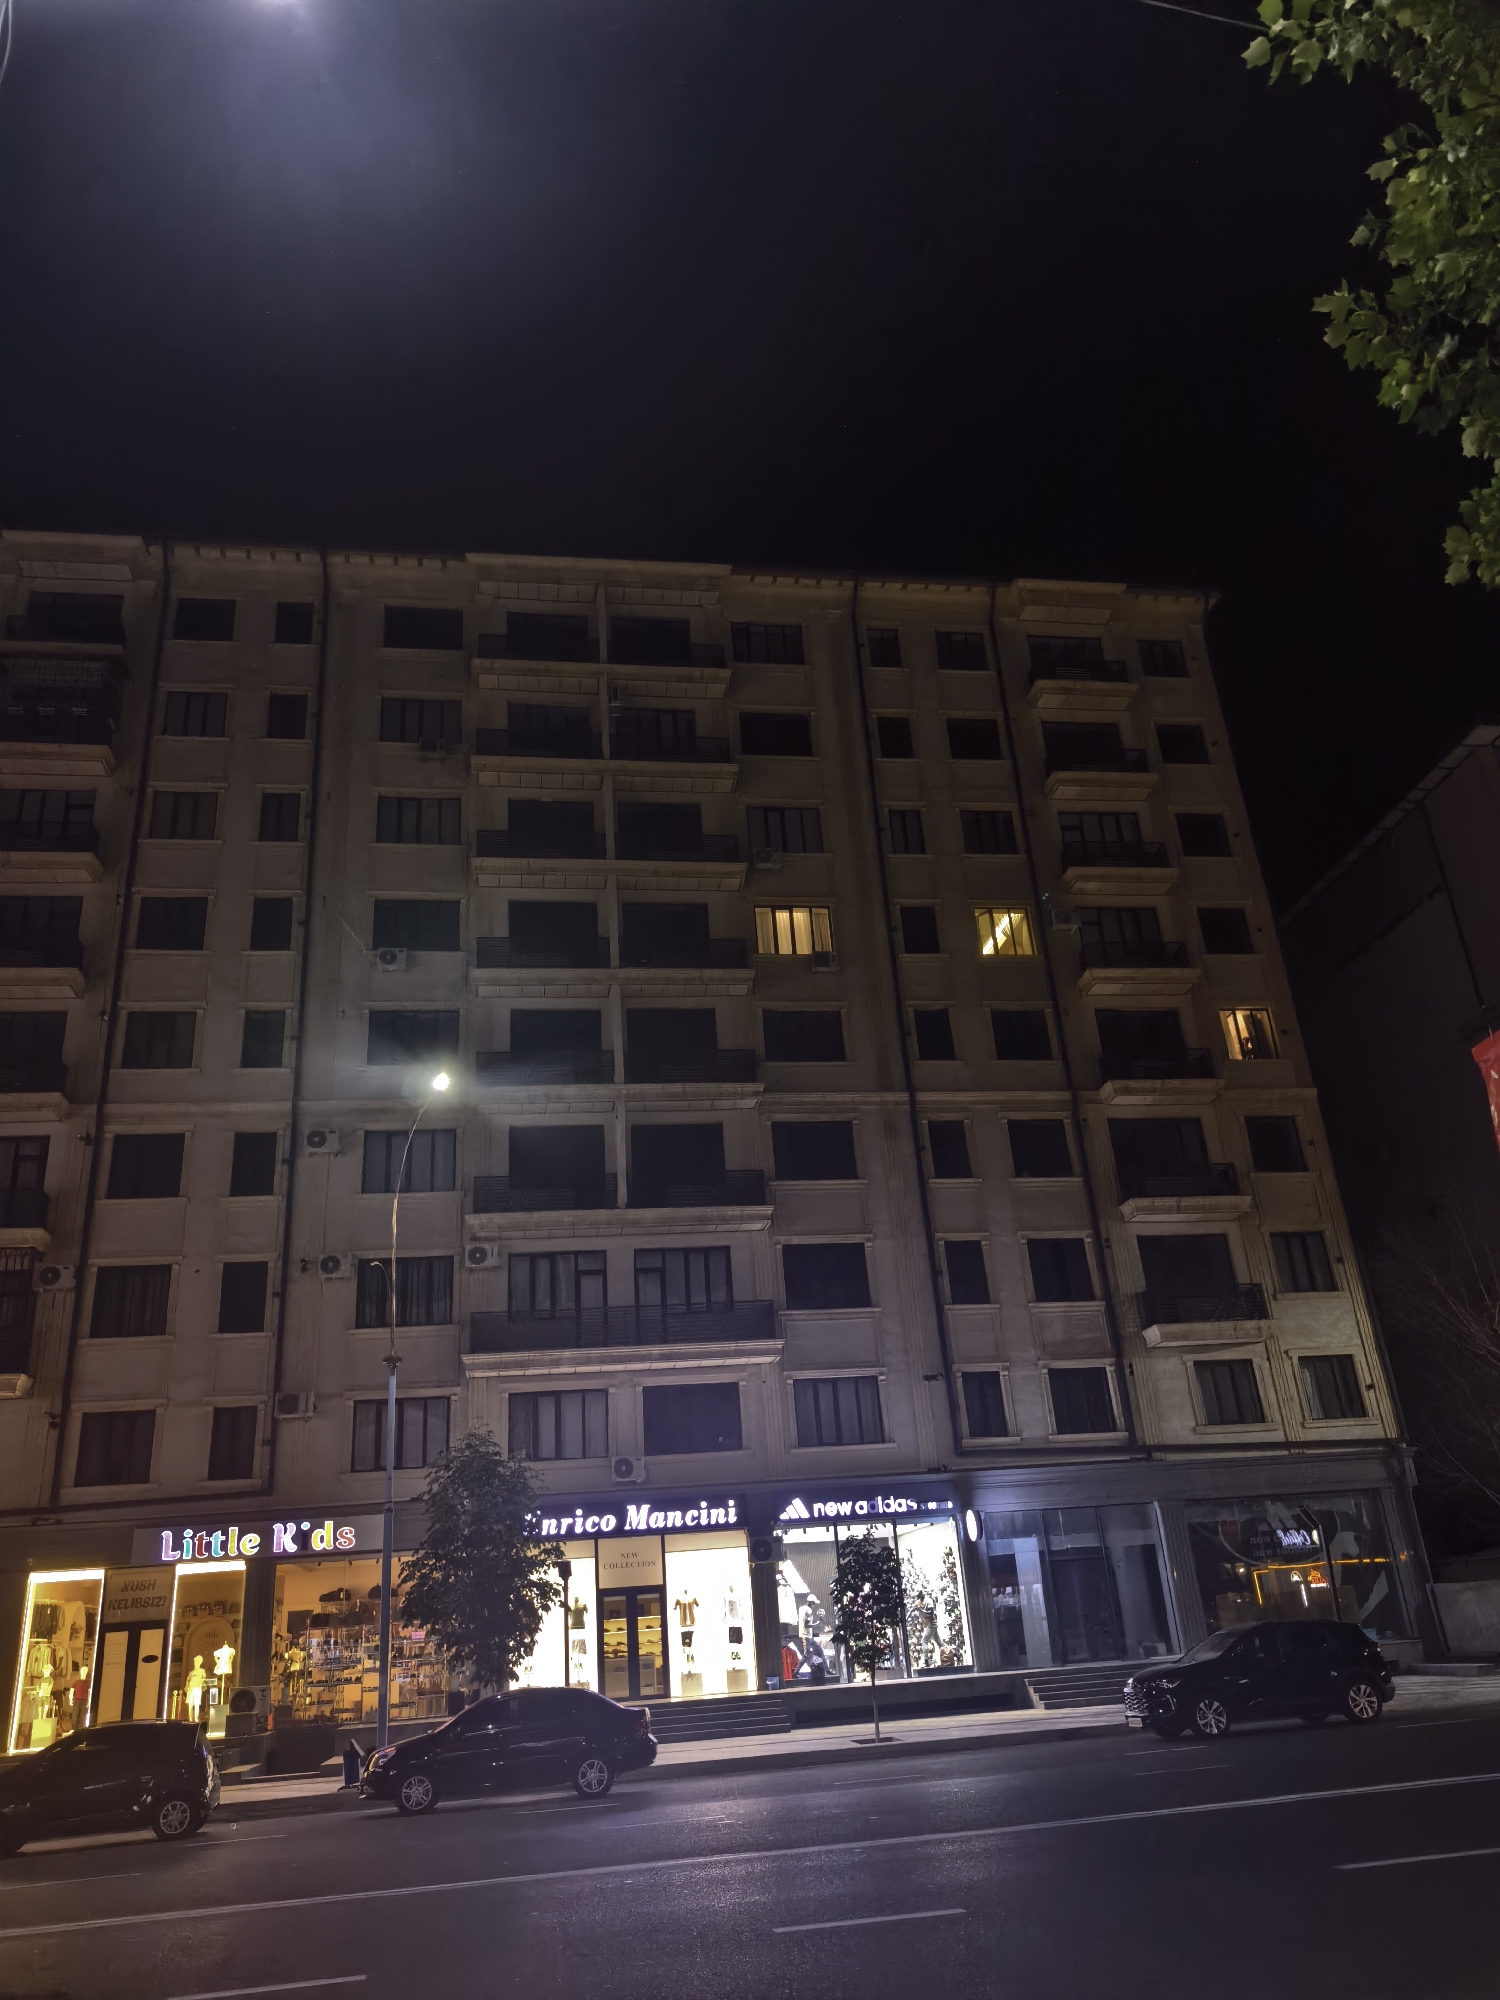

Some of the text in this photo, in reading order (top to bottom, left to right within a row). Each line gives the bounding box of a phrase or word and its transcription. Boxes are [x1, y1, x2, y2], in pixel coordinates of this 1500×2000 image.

[623, 1499, 738, 1530] Mancini
[813, 1500, 853, 1517] new
[855, 1495, 918, 1514] adidas
[161, 1520, 355, 1560] Little Kids
[603, 1560, 656, 1570] COLLECTION
[120, 1579, 157, 1593] XUSH
[107, 1595, 167, 1611] KELIBSIZ!
